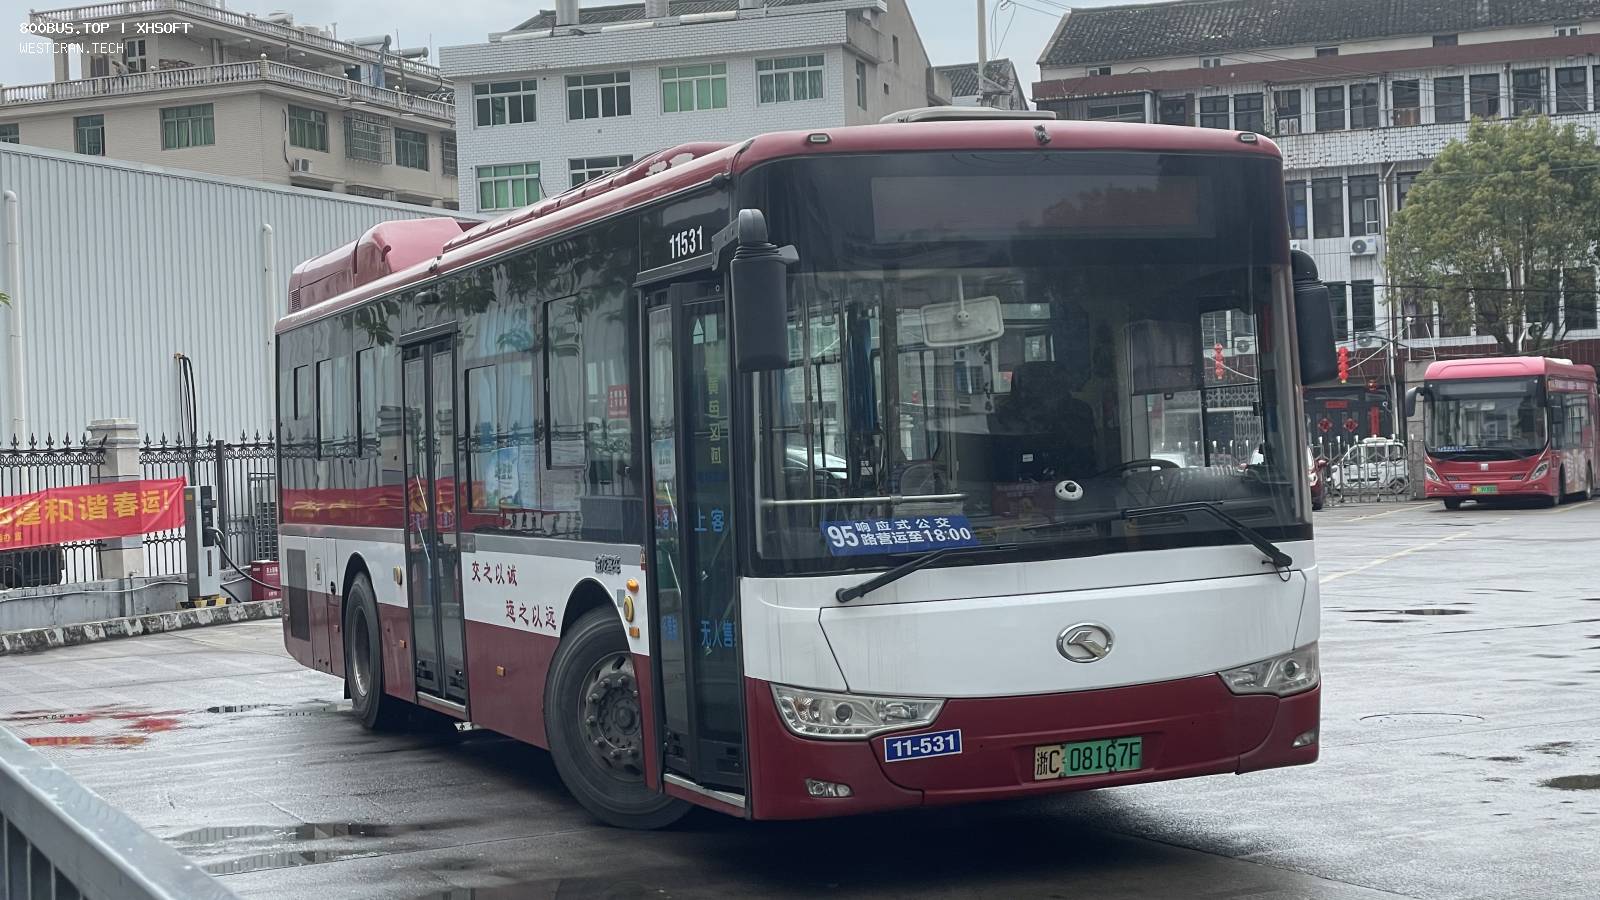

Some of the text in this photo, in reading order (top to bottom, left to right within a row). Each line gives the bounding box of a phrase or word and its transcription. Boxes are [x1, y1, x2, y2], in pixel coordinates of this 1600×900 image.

[669, 225, 702, 259] 11531
[827, 525, 859, 548] 95
[855, 517, 951, 533] 响应式公交
[860, 527, 971, 546] 路营运至18:00
[472, 560, 518, 587] 交之以诚
[892, 734, 957, 757] 11-531
